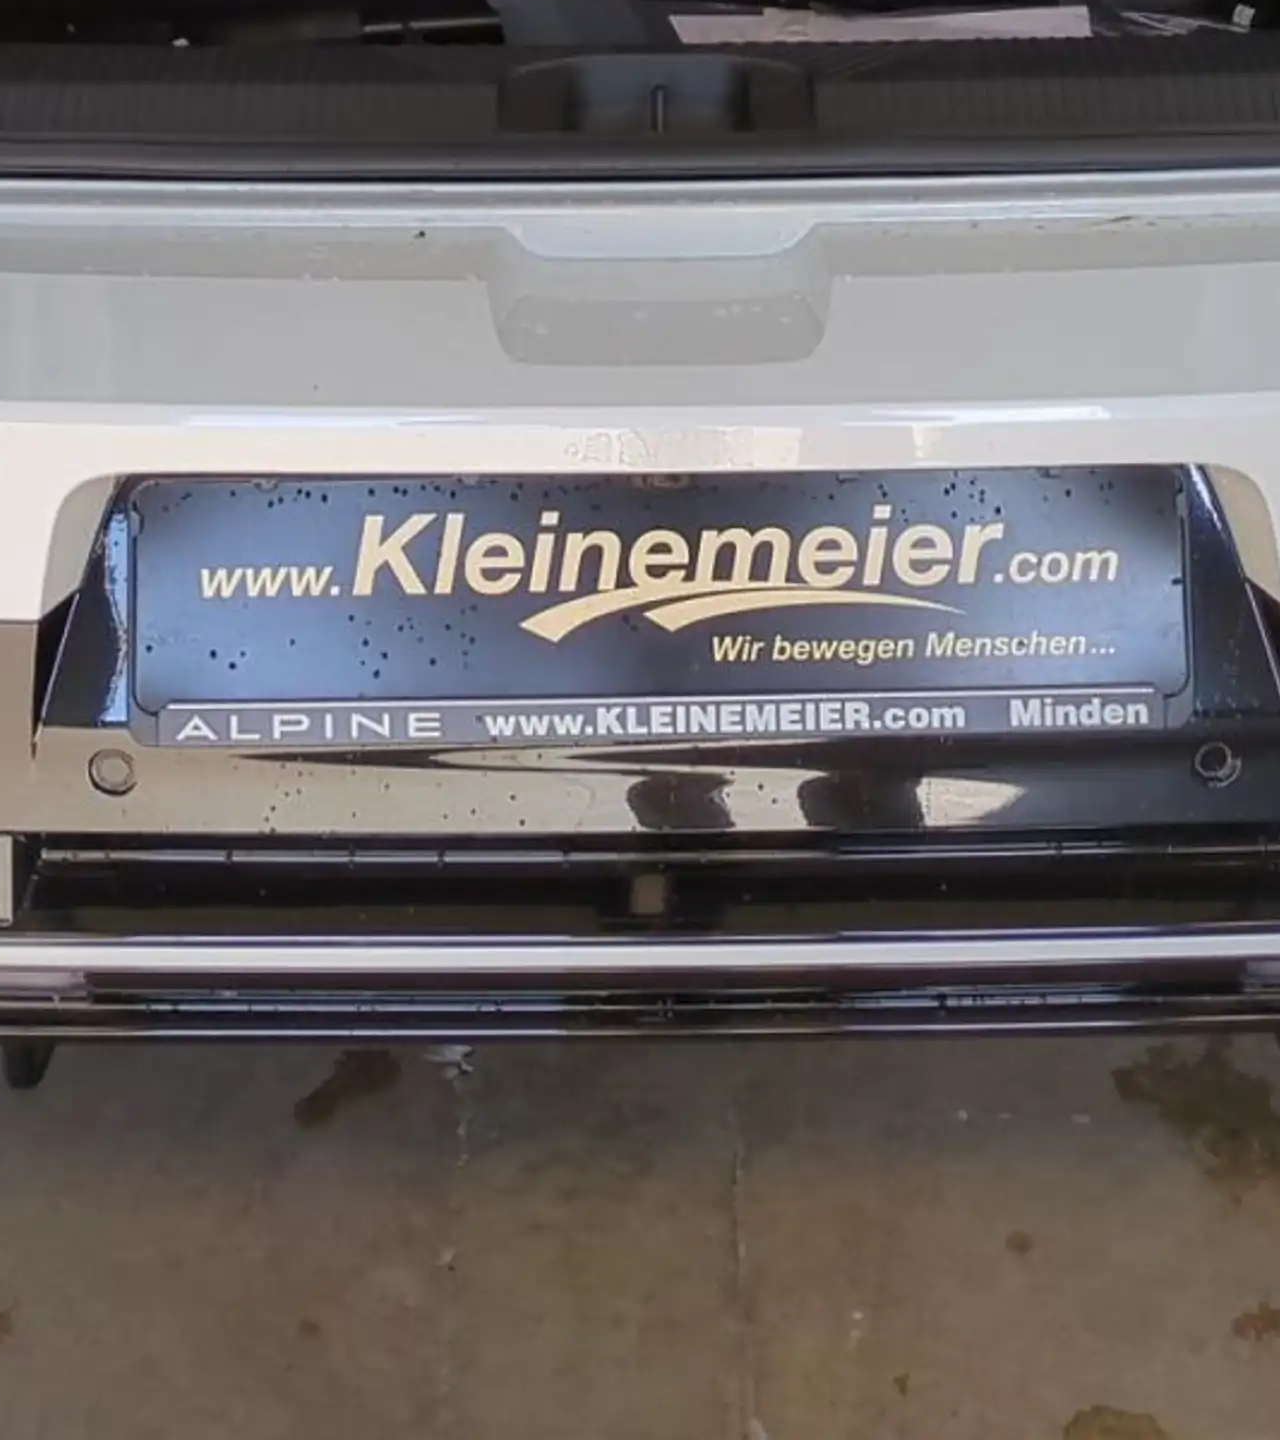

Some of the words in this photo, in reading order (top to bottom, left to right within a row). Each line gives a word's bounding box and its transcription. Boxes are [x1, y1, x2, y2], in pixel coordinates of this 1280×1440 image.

[199, 504, 1119, 598] www.Kleinemeier.com
[712, 634, 762, 662] Wir
[772, 633, 915, 666] bewegen
[925, 629, 1117, 659] Menschen...
[176, 711, 443, 742] ALPINE
[483, 699, 967, 738] www.KLEINEMEIER.com
[1009, 696, 1150, 727] Minden
